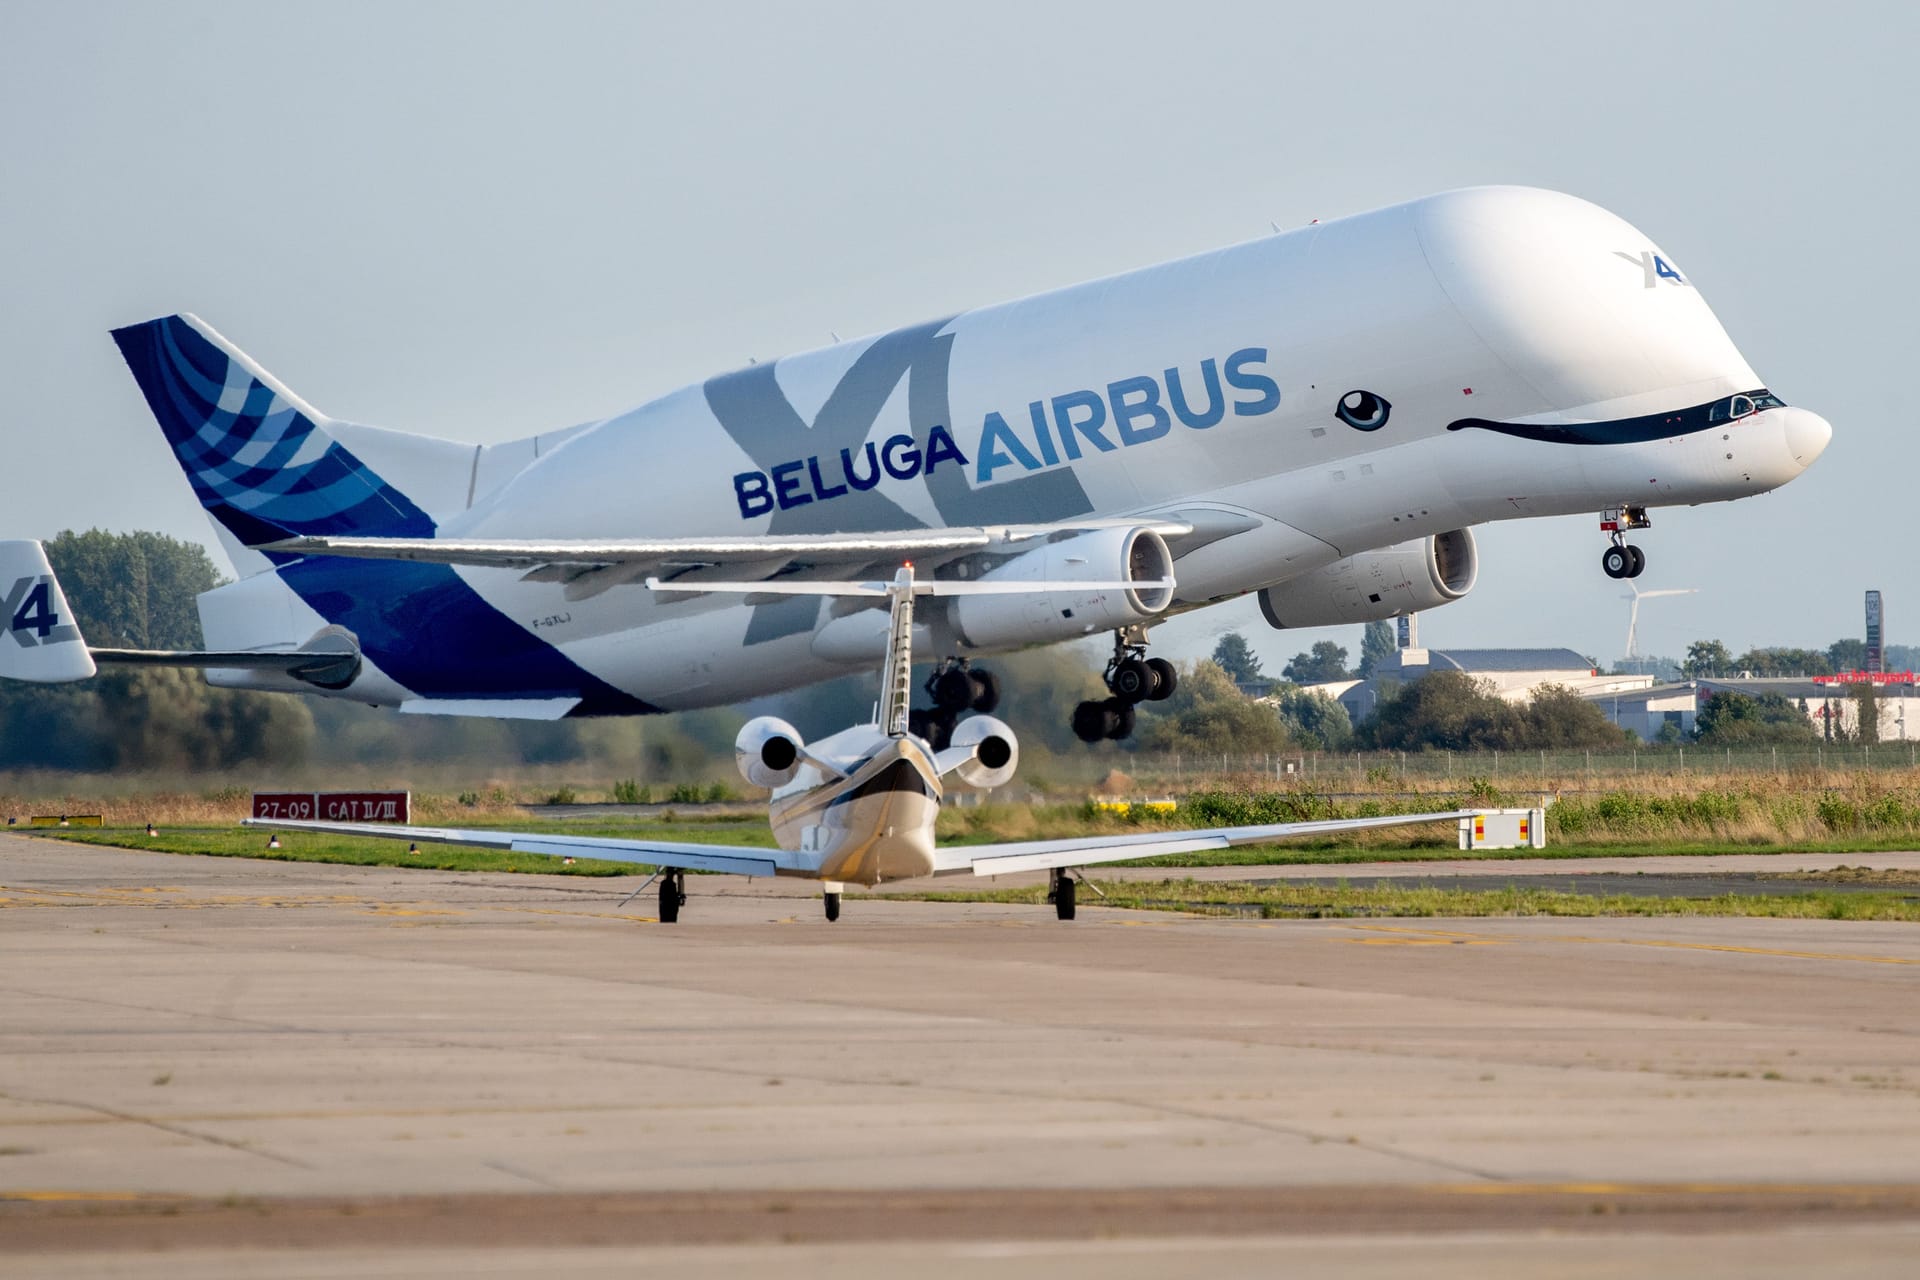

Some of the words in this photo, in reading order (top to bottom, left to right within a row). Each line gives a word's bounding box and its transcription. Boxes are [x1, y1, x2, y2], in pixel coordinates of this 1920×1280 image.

[732, 425, 969, 519] BELUGA
[976, 347, 1281, 482] AIRBUS
[259, 802, 310, 819] 27-09
[328, 801, 358, 819] CAT
